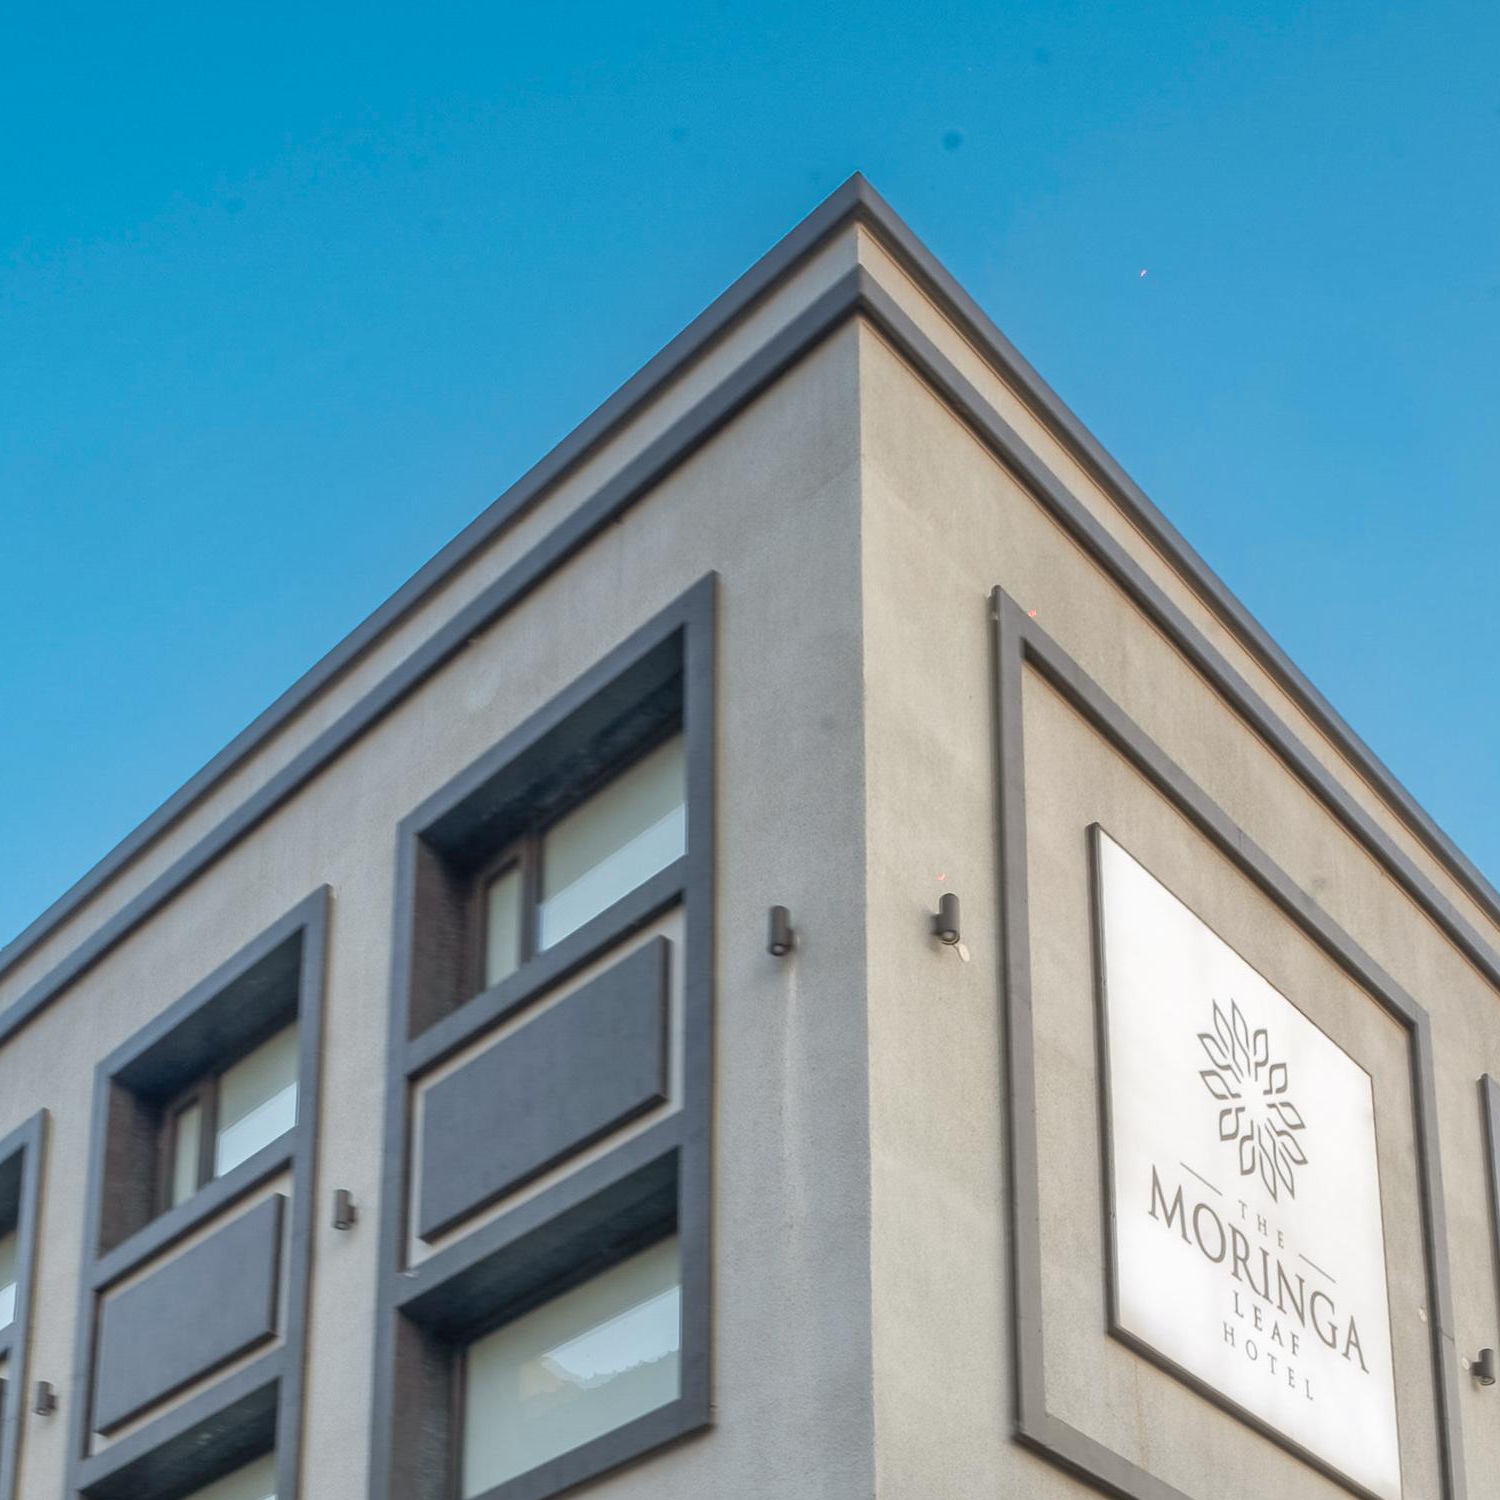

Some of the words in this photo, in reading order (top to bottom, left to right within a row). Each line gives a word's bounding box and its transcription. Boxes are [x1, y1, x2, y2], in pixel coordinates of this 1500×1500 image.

[1237, 1199, 1285, 1250] THE
[1147, 1163, 1370, 1375] MORINGA
[1232, 1289, 1301, 1357] LEAF
[1222, 1320, 1314, 1401] HOTEL
